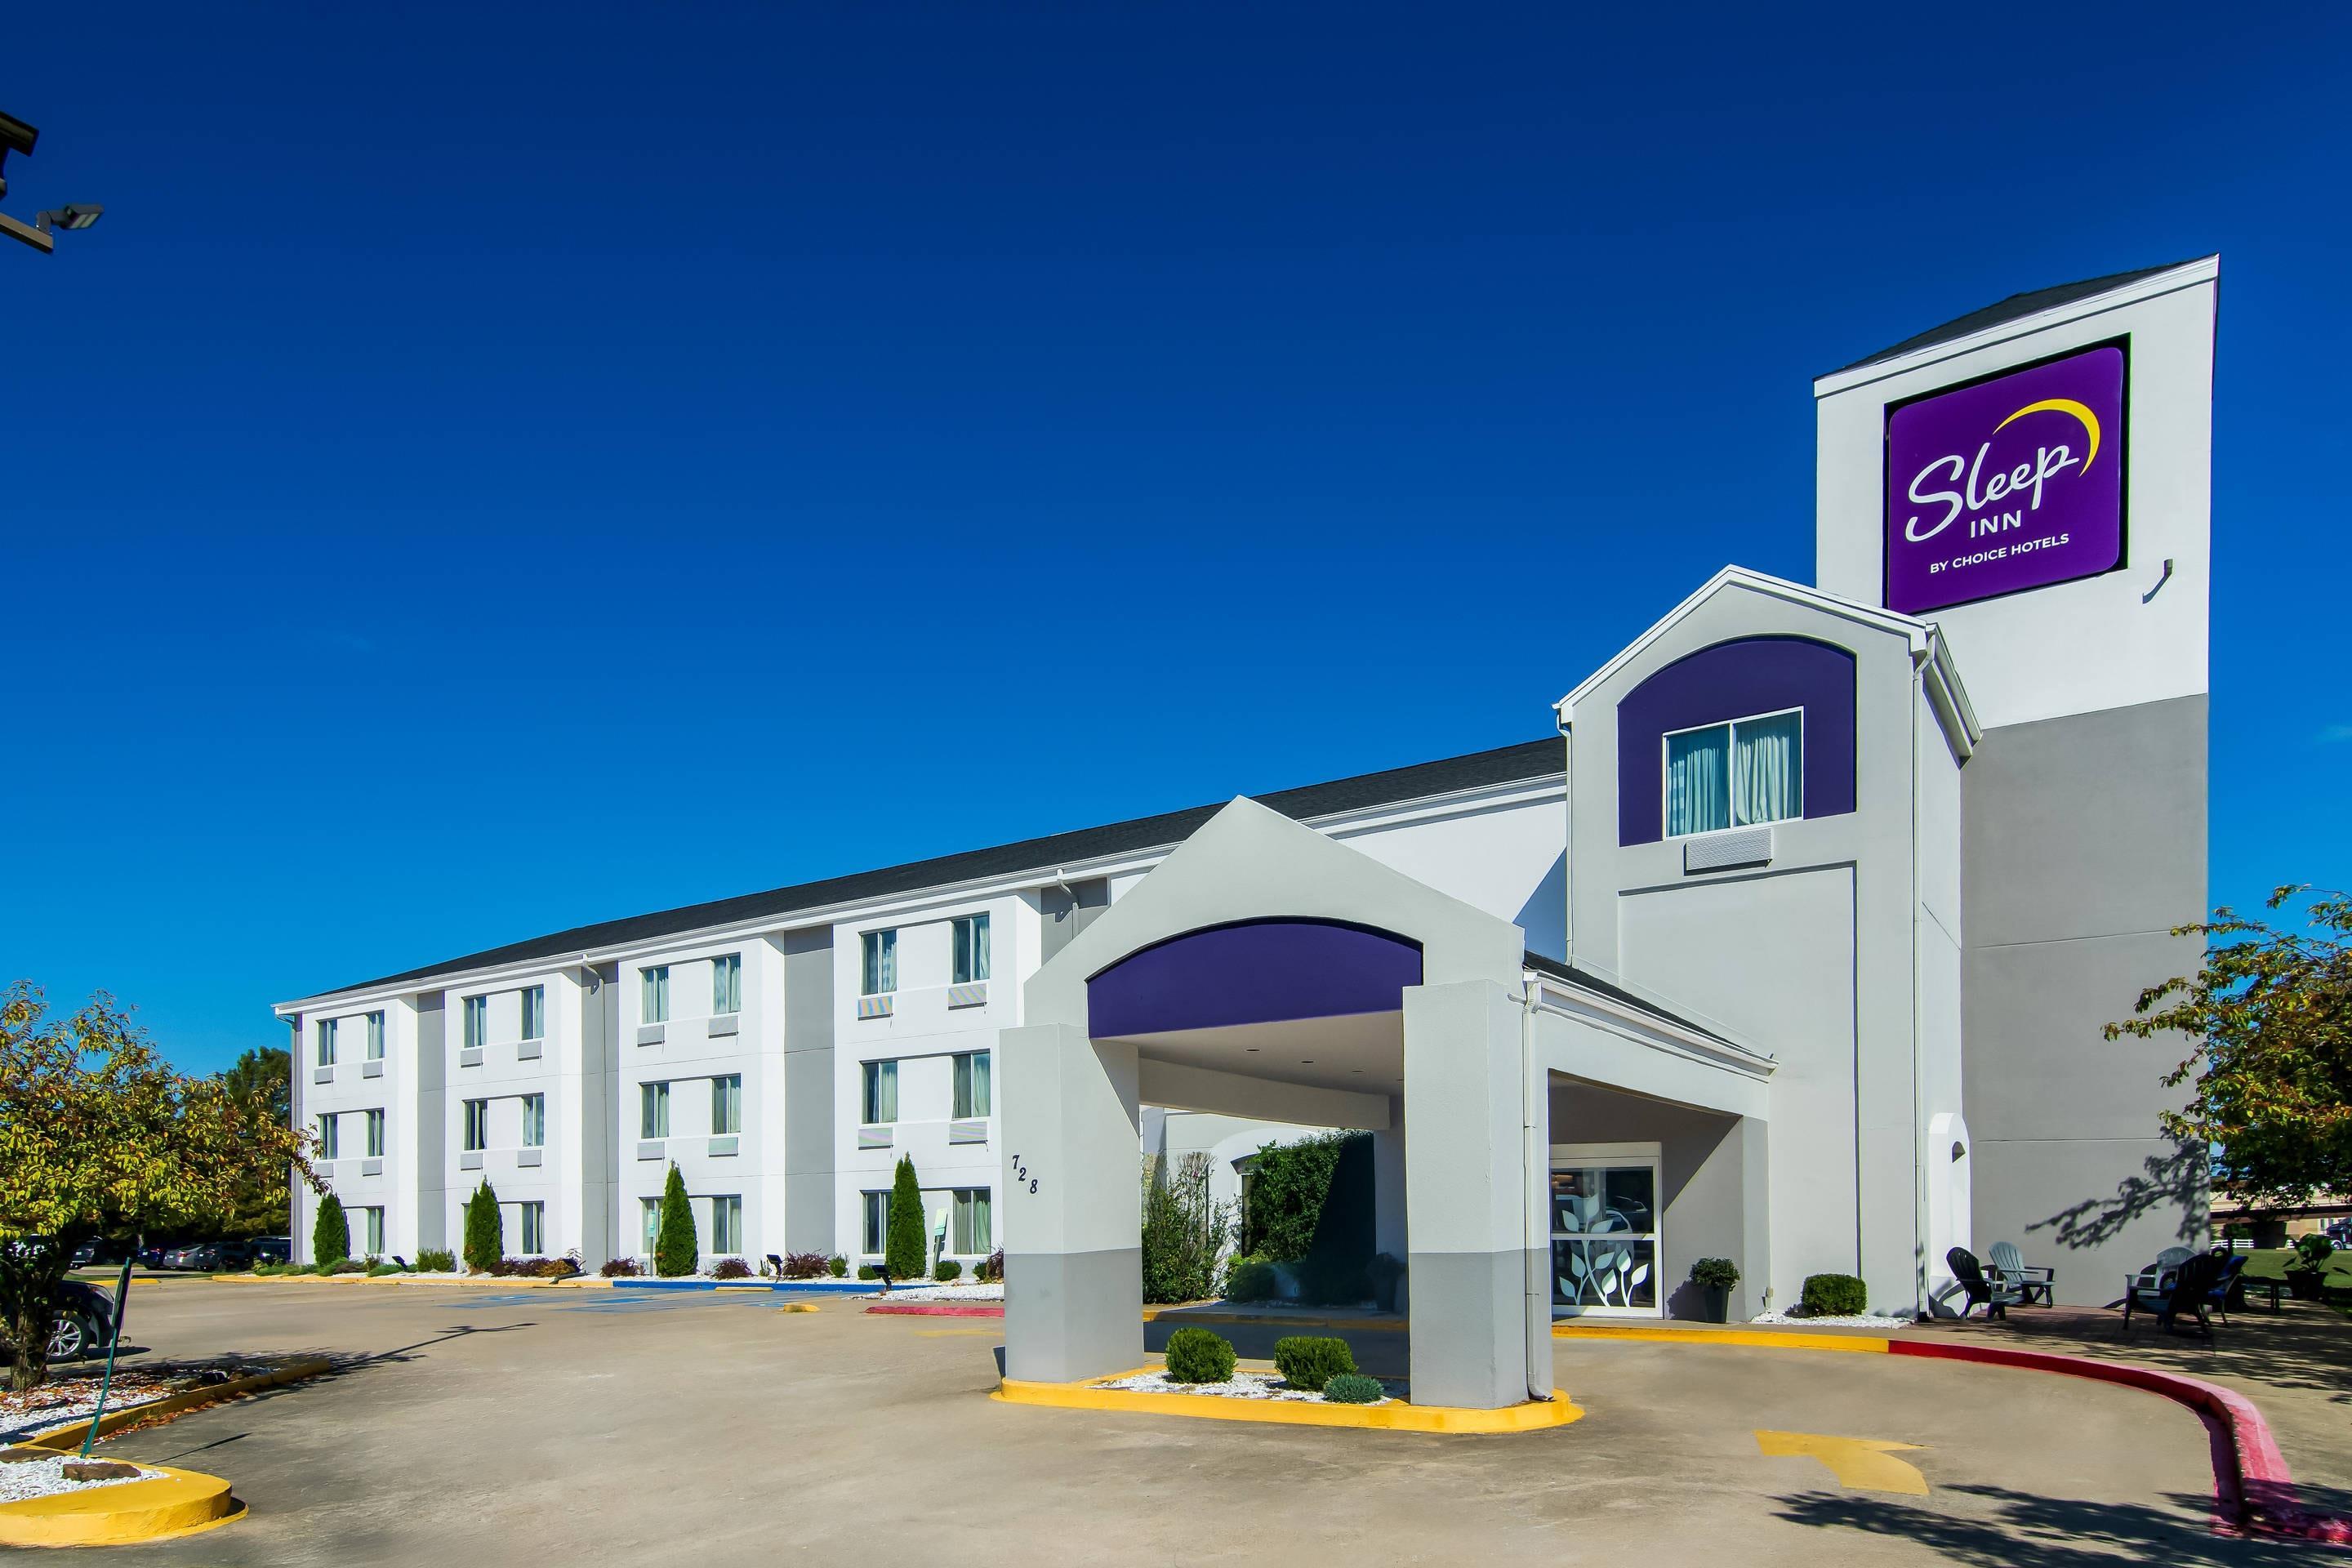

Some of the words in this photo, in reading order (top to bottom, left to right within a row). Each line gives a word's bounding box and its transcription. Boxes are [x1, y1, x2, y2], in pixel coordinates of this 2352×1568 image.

[1905, 442, 2079, 542] Sleep
[1970, 510, 2021, 538] INN
[1930, 561, 1949, 573] BY
[1952, 548, 2007, 568] CHOICE
[2011, 533, 2069, 555] HOTELS
[1013, 1154, 1038, 1194] 728
